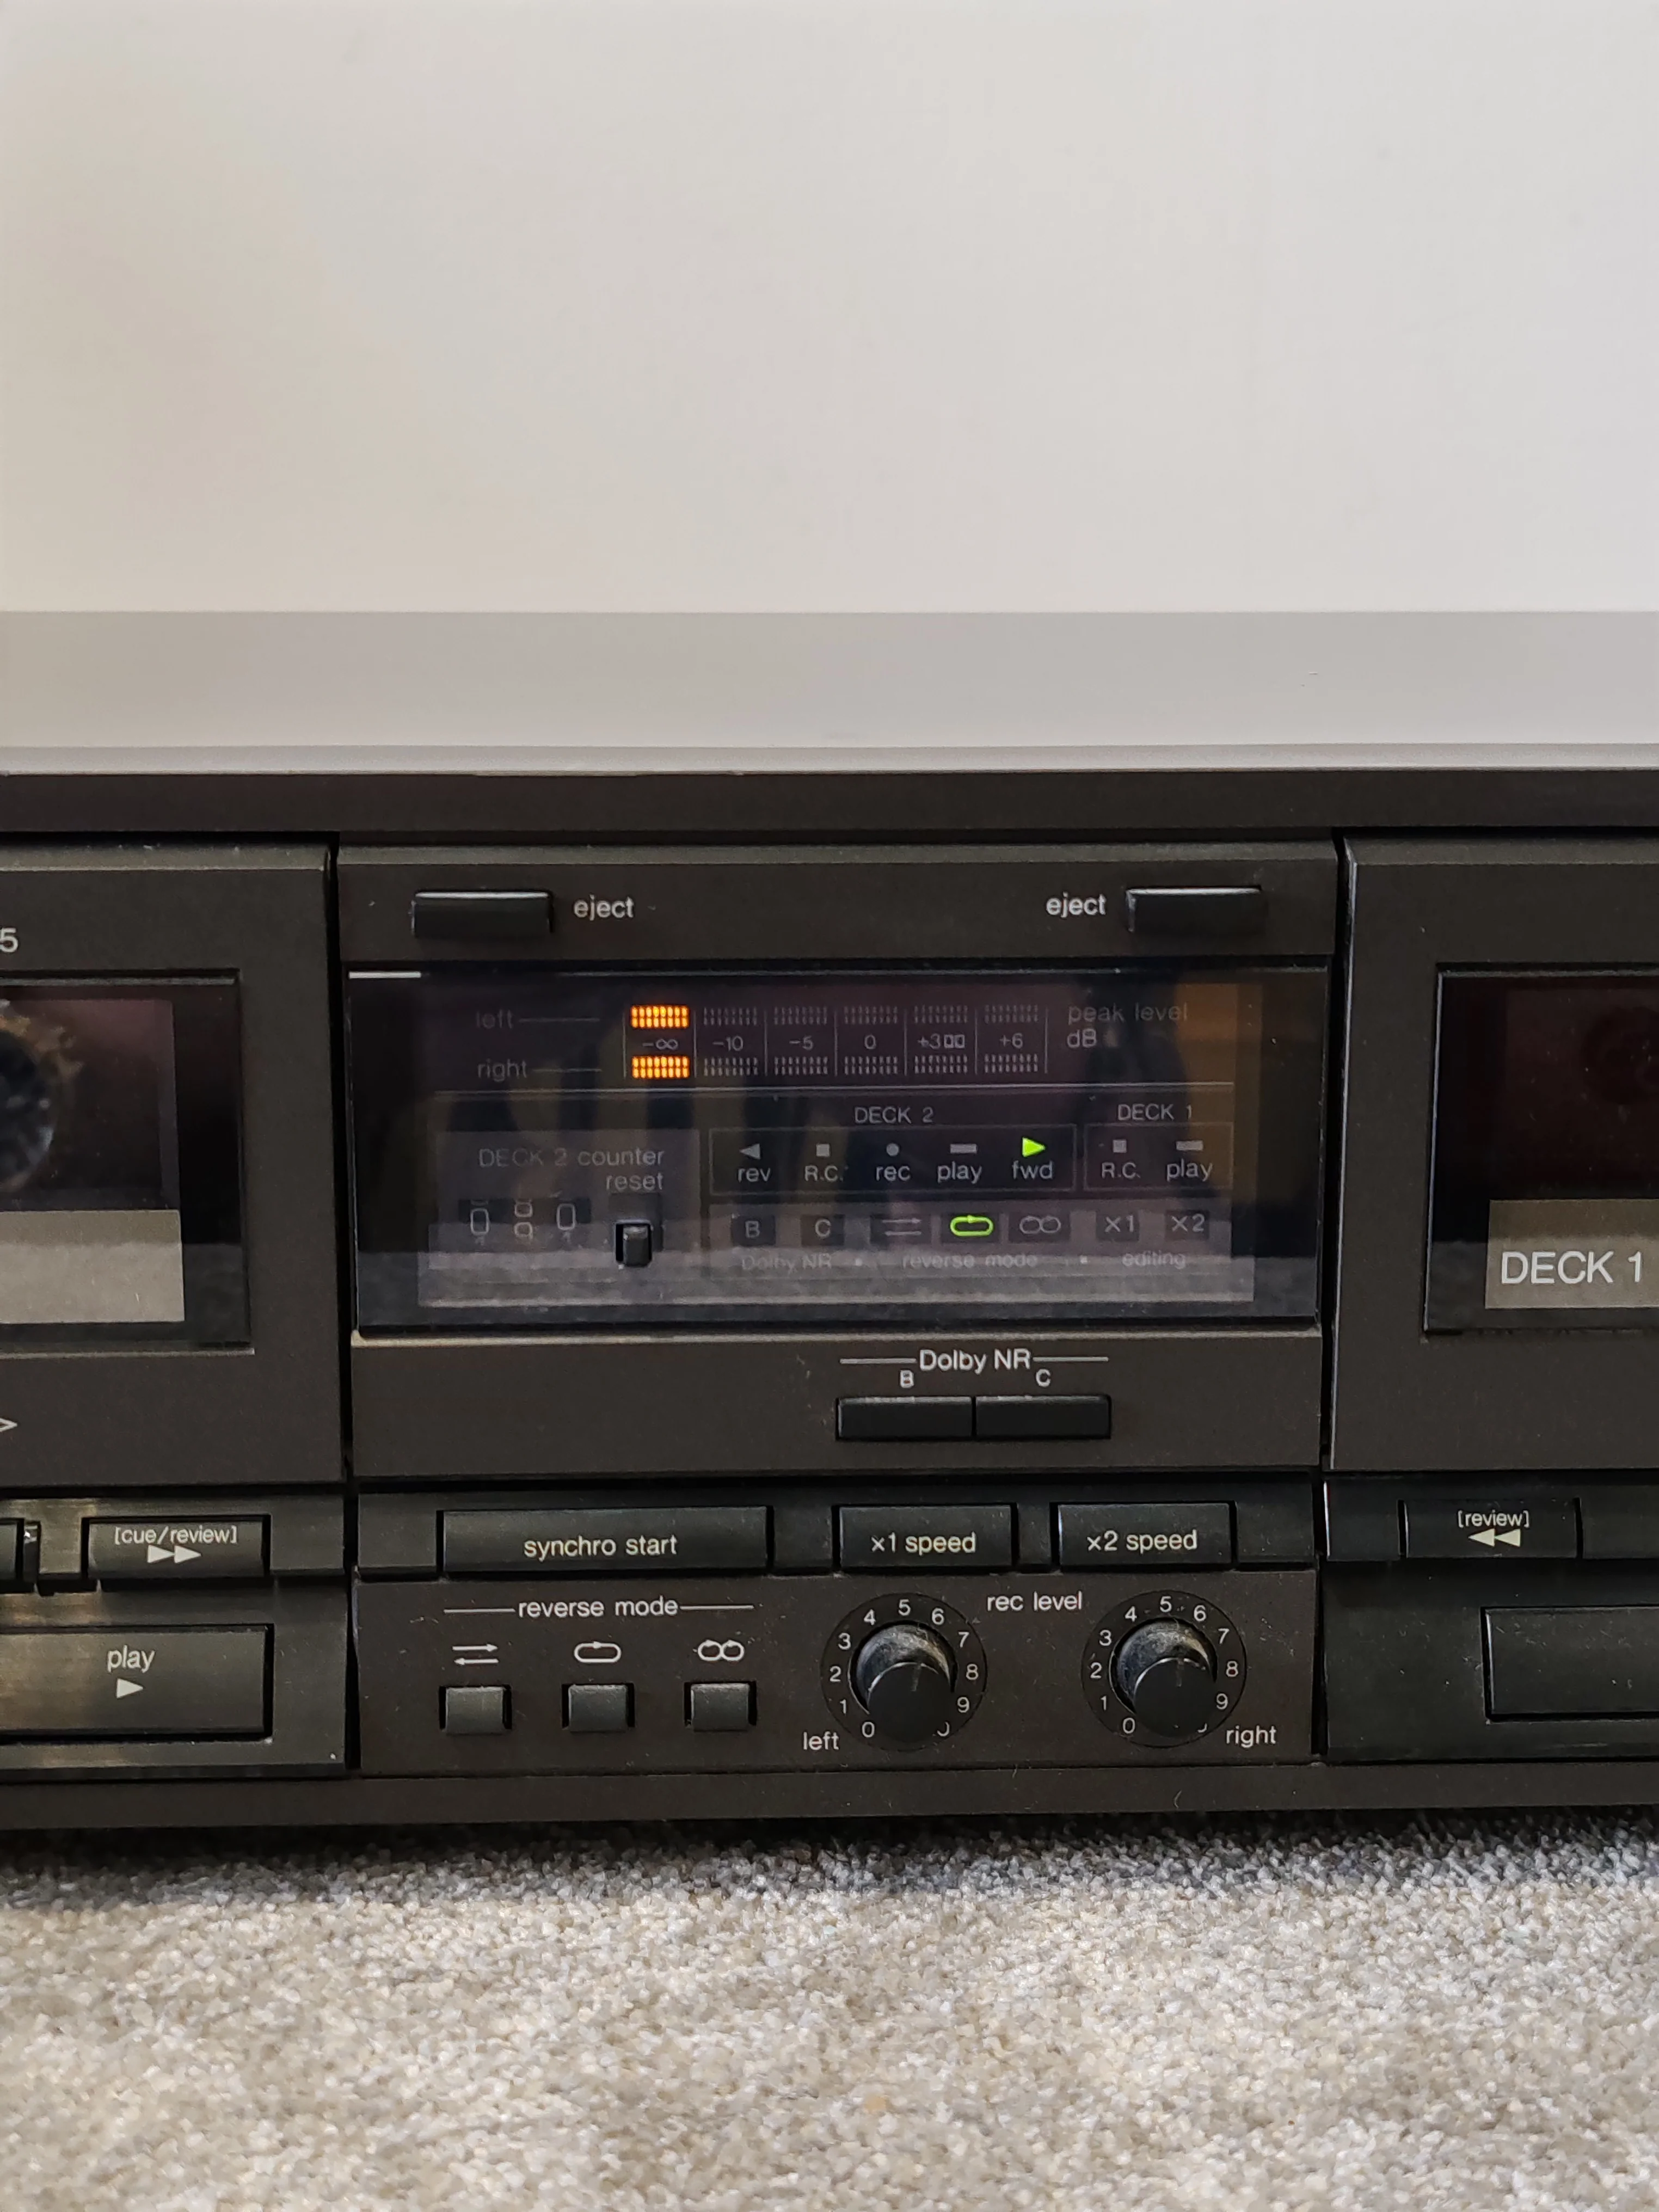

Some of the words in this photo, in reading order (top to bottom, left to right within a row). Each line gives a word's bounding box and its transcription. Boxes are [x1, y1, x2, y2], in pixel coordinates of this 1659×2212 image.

[574, 894, 634, 921] eject
[1046, 891, 1106, 918] eject
[476, 1009, 514, 1030] left
[1067, 1003, 1125, 1024] peak
[1135, 1003, 1188, 1021] level
[712, 1036, 743, 1051] -10
[789, 1035, 813, 1049] -5
[864, 1035, 876, 1049] 0
[1000, 1033, 1023, 1048] +6
[1067, 1028, 1097, 1048] dB
[477, 1058, 527, 1082] right
[855, 1107, 912, 1123] DECK
[922, 1107, 934, 1123] 2
[1117, 1104, 1174, 1121] DECK
[1186, 1105, 1193, 1119] 1
[479, 1147, 543, 1168] DECK
[554, 1149, 567, 1166] 2
[577, 1147, 665, 1167] counter
[738, 1167, 771, 1182] rev
[875, 1165, 911, 1181] rec
[937, 1162, 982, 1183] play
[1012, 1160, 1054, 1180] fwd
[1102, 1163, 1141, 1179] R.C.
[1166, 1159, 1214, 1182] play
[605, 1172, 664, 1191] reset
[745, 1220, 760, 1238] B
[815, 1219, 832, 1238] C
[902, 1254, 974, 1269] reverse
[985, 1251, 1038, 1268] mode
[1122, 1250, 1187, 1270] editing
[1501, 1251, 1614, 1284] DECK
[1628, 1251, 1642, 1283] 1
[920, 1349, 986, 1374] Dolby
[994, 1348, 1031, 1370] NR
[900, 1369, 914, 1388] B
[1036, 1369, 1052, 1387] C
[1458, 1509, 1530, 1528] [review]
[114, 1525, 237, 1545] [cue/review]
[871, 1532, 897, 1553] x1
[905, 1531, 976, 1556] speed
[1087, 1530, 1119, 1552] x2
[1126, 1529, 1198, 1554] speed
[524, 1535, 617, 1562] synchro
[625, 1535, 678, 1556] start
[518, 1598, 604, 1618] reverse
[615, 1595, 679, 1617] mode
[899, 1599, 911, 1616] 5
[987, 1593, 1023, 1612] rec
[1034, 1590, 1083, 1612] level
[1159, 1596, 1172, 1613] 5
[863, 1609, 875, 1626] 4
[931, 1608, 944, 1625] 6
[1125, 1605, 1138, 1621] 4
[1193, 1605, 1207, 1622] 6
[838, 1633, 851, 1650] 3
[958, 1632, 969, 1648] 7
[1099, 1630, 1112, 1646] 3
[1218, 1628, 1230, 1644] 7
[108, 1645, 156, 1674] play
[830, 1666, 841, 1682] 2
[966, 1664, 979, 1680] 8
[1090, 1663, 1102, 1679] 2
[1226, 1661, 1239, 1677] 8
[840, 1699, 847, 1714] 1
[957, 1697, 970, 1713] 9
[1100, 1696, 1107, 1711] 1
[1216, 1693, 1228, 1710] 9
[862, 1722, 875, 1738] 0
[1122, 1718, 1135, 1734] 0
[802, 1731, 840, 1750] left
[1226, 1725, 1277, 1748] right
